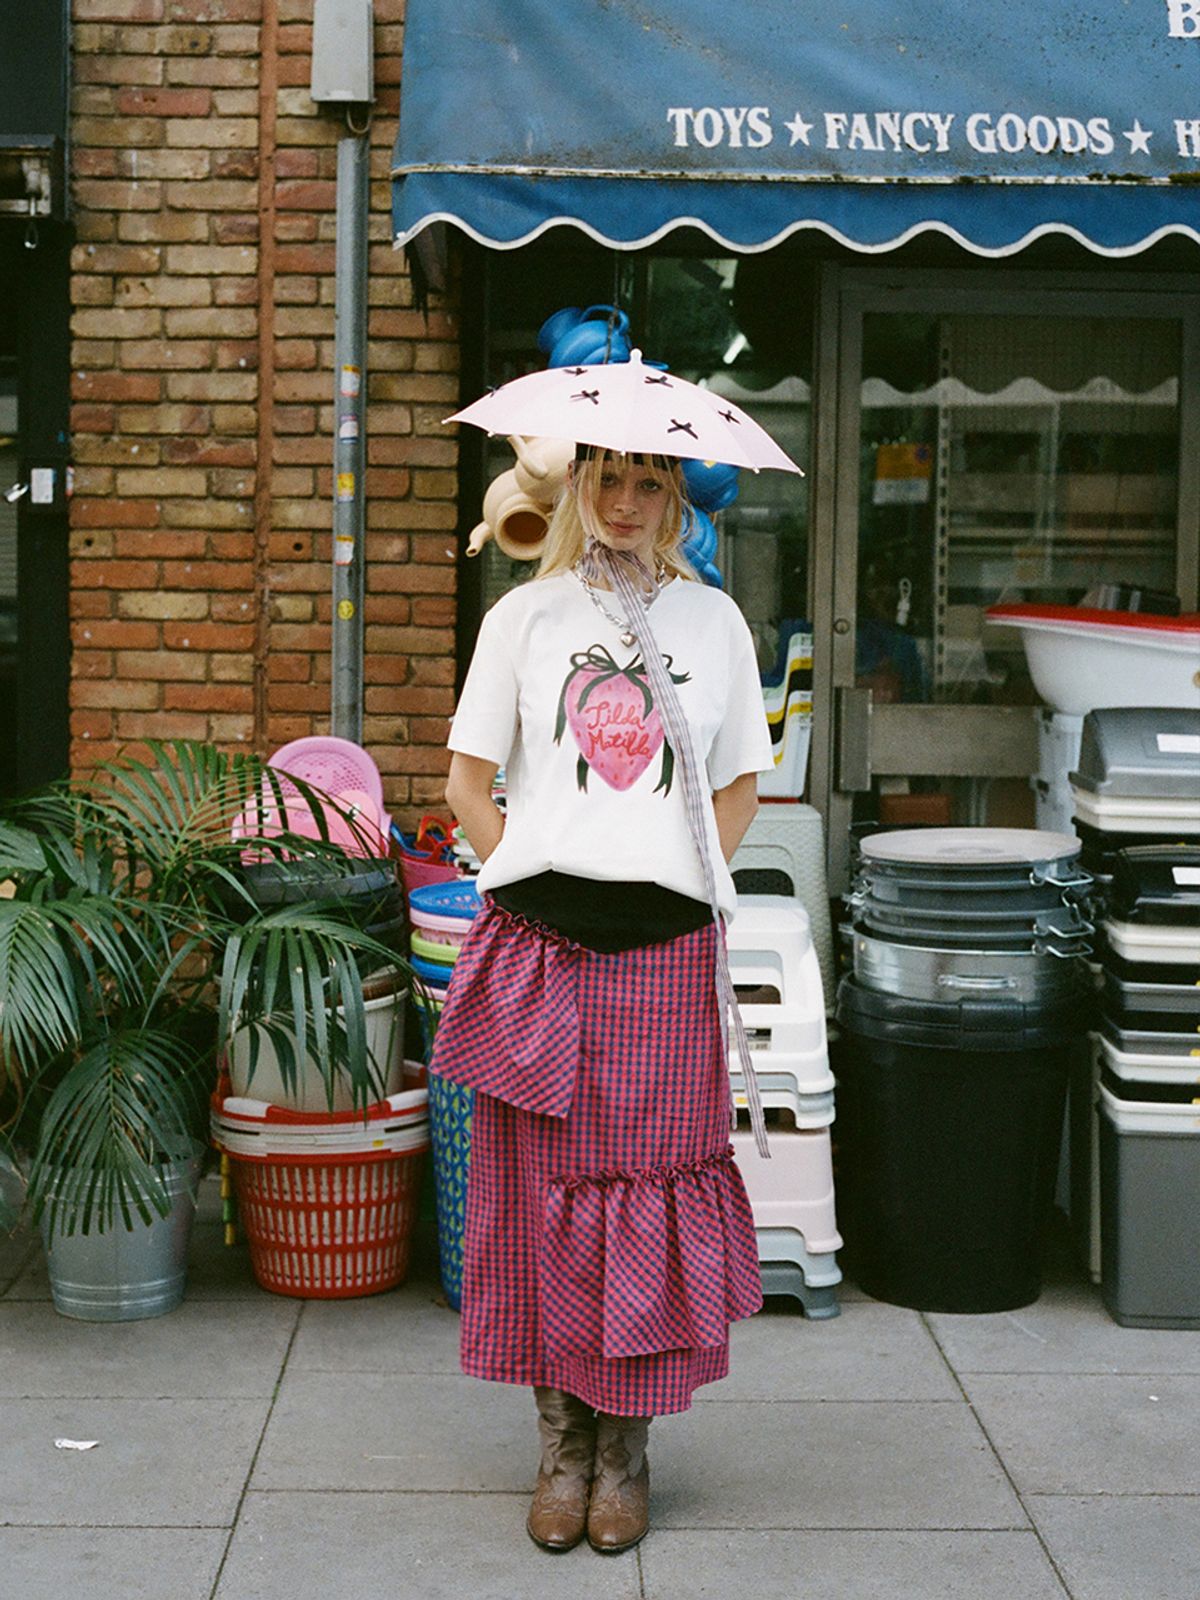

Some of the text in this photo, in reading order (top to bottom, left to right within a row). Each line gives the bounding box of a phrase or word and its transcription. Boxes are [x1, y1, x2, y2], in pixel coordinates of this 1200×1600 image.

[667, 107, 773, 149] TOYS
[824, 112, 955, 153] FANCY
[966, 114, 1115, 155] GOODS
[585, 701, 645, 730] Tilda
